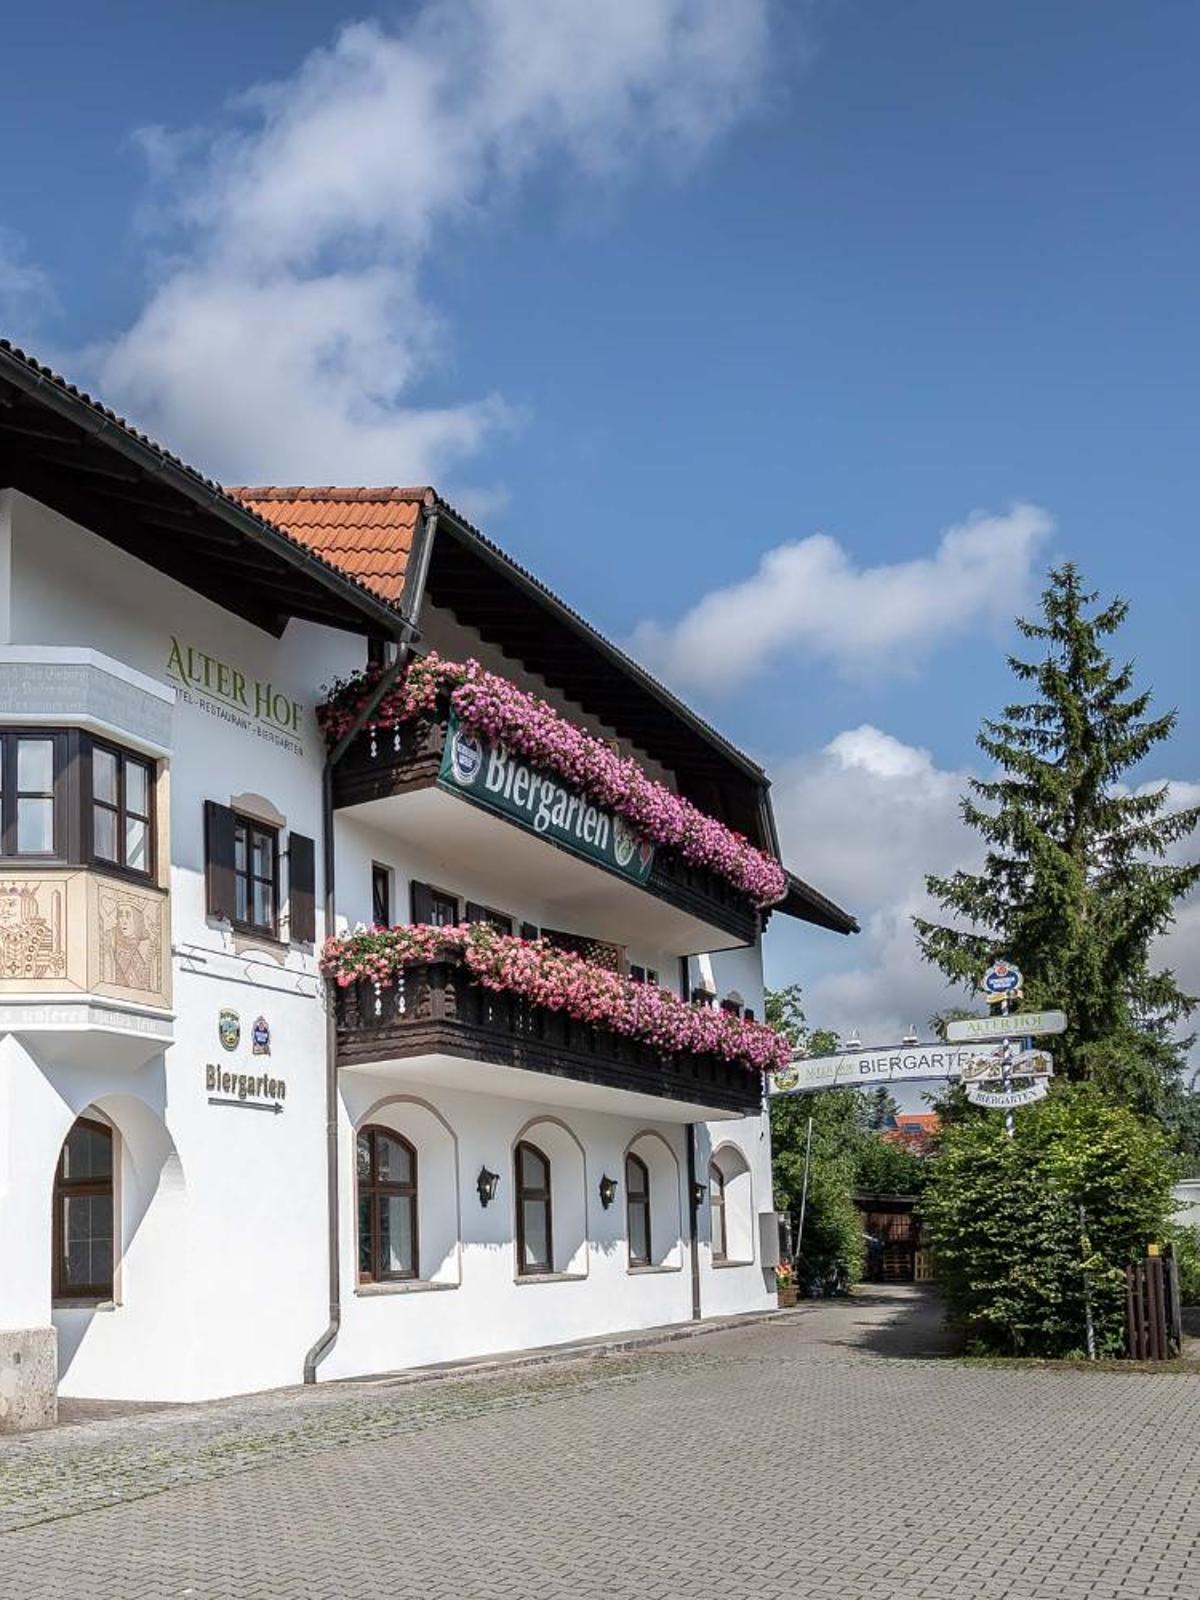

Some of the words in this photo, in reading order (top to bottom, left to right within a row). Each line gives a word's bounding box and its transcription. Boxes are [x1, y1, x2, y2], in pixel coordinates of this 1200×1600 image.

[166, 635, 248, 707] ALTER
[254, 681, 303, 731] HOF
[485, 747, 610, 850] Biergarten
[968, 1017, 1009, 1033] ALTER
[205, 1063, 286, 1100] Biergarten
[975, 1090, 1038, 1105] BIERGARTEN
